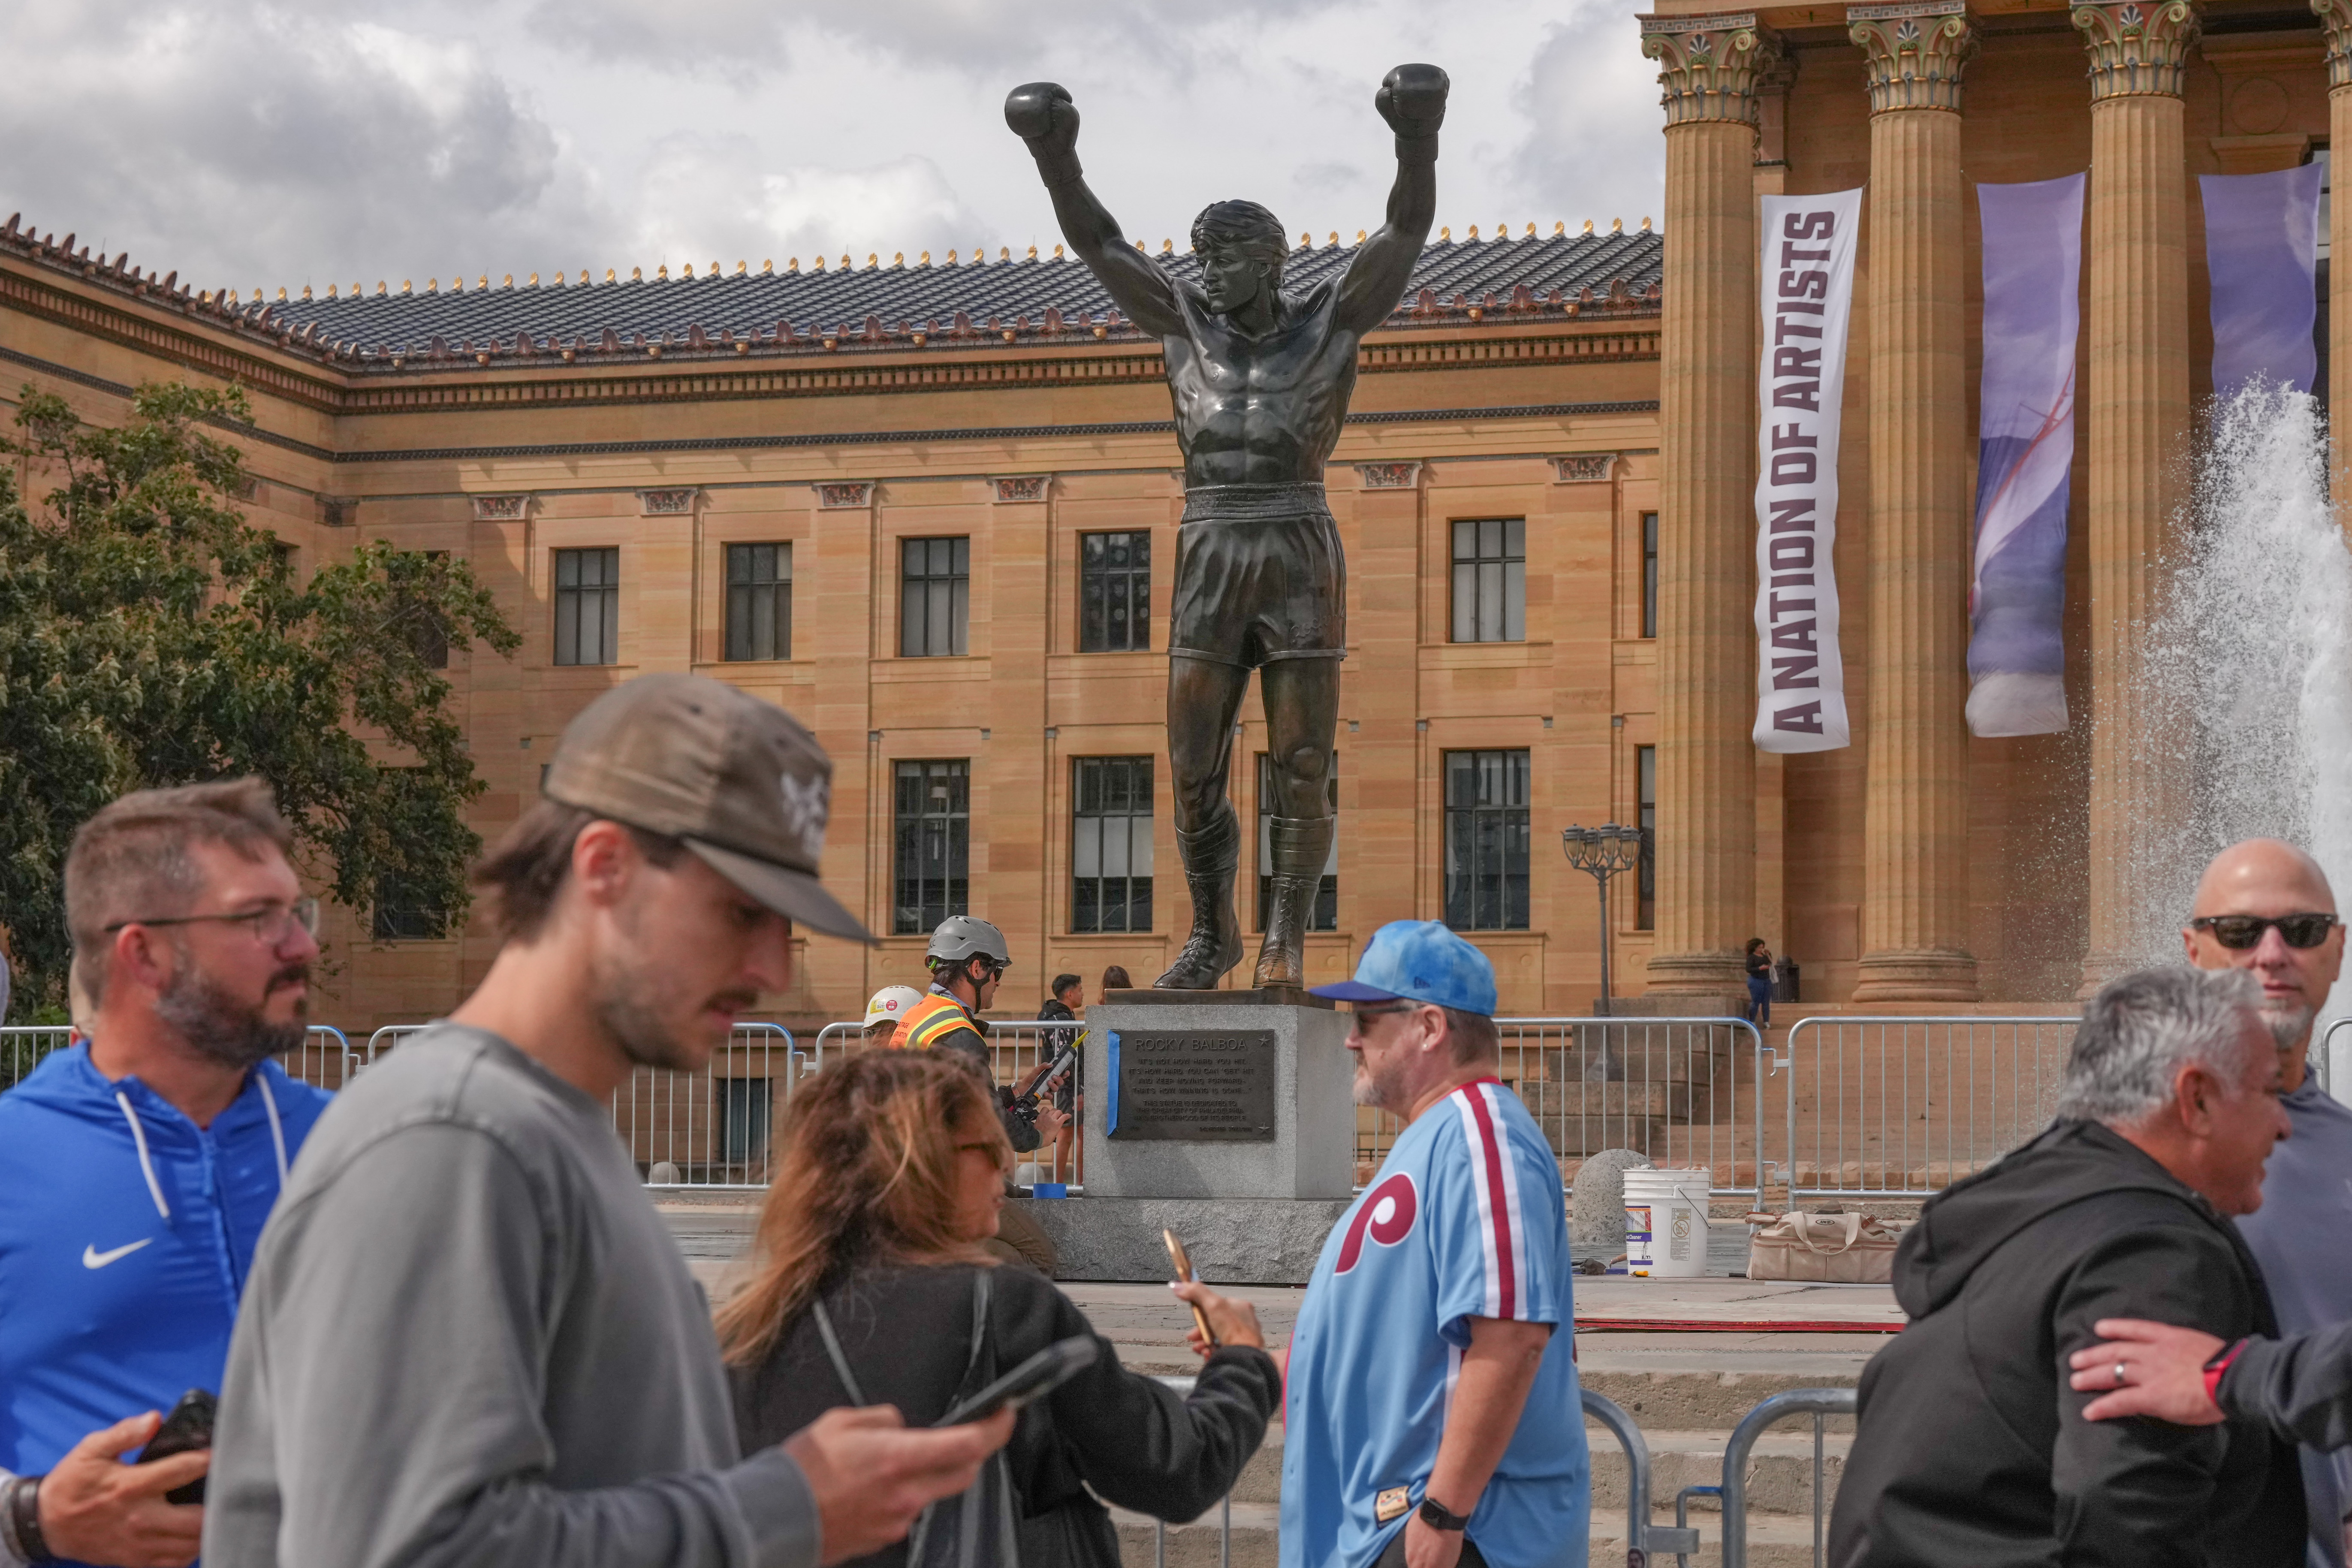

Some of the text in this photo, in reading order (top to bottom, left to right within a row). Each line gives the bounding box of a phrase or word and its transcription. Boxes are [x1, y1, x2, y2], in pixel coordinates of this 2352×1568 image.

[1770, 211, 1835, 735] A NATION OF ARTISTS
[1135, 1038, 1248, 1051] ROCKY BALBOA
